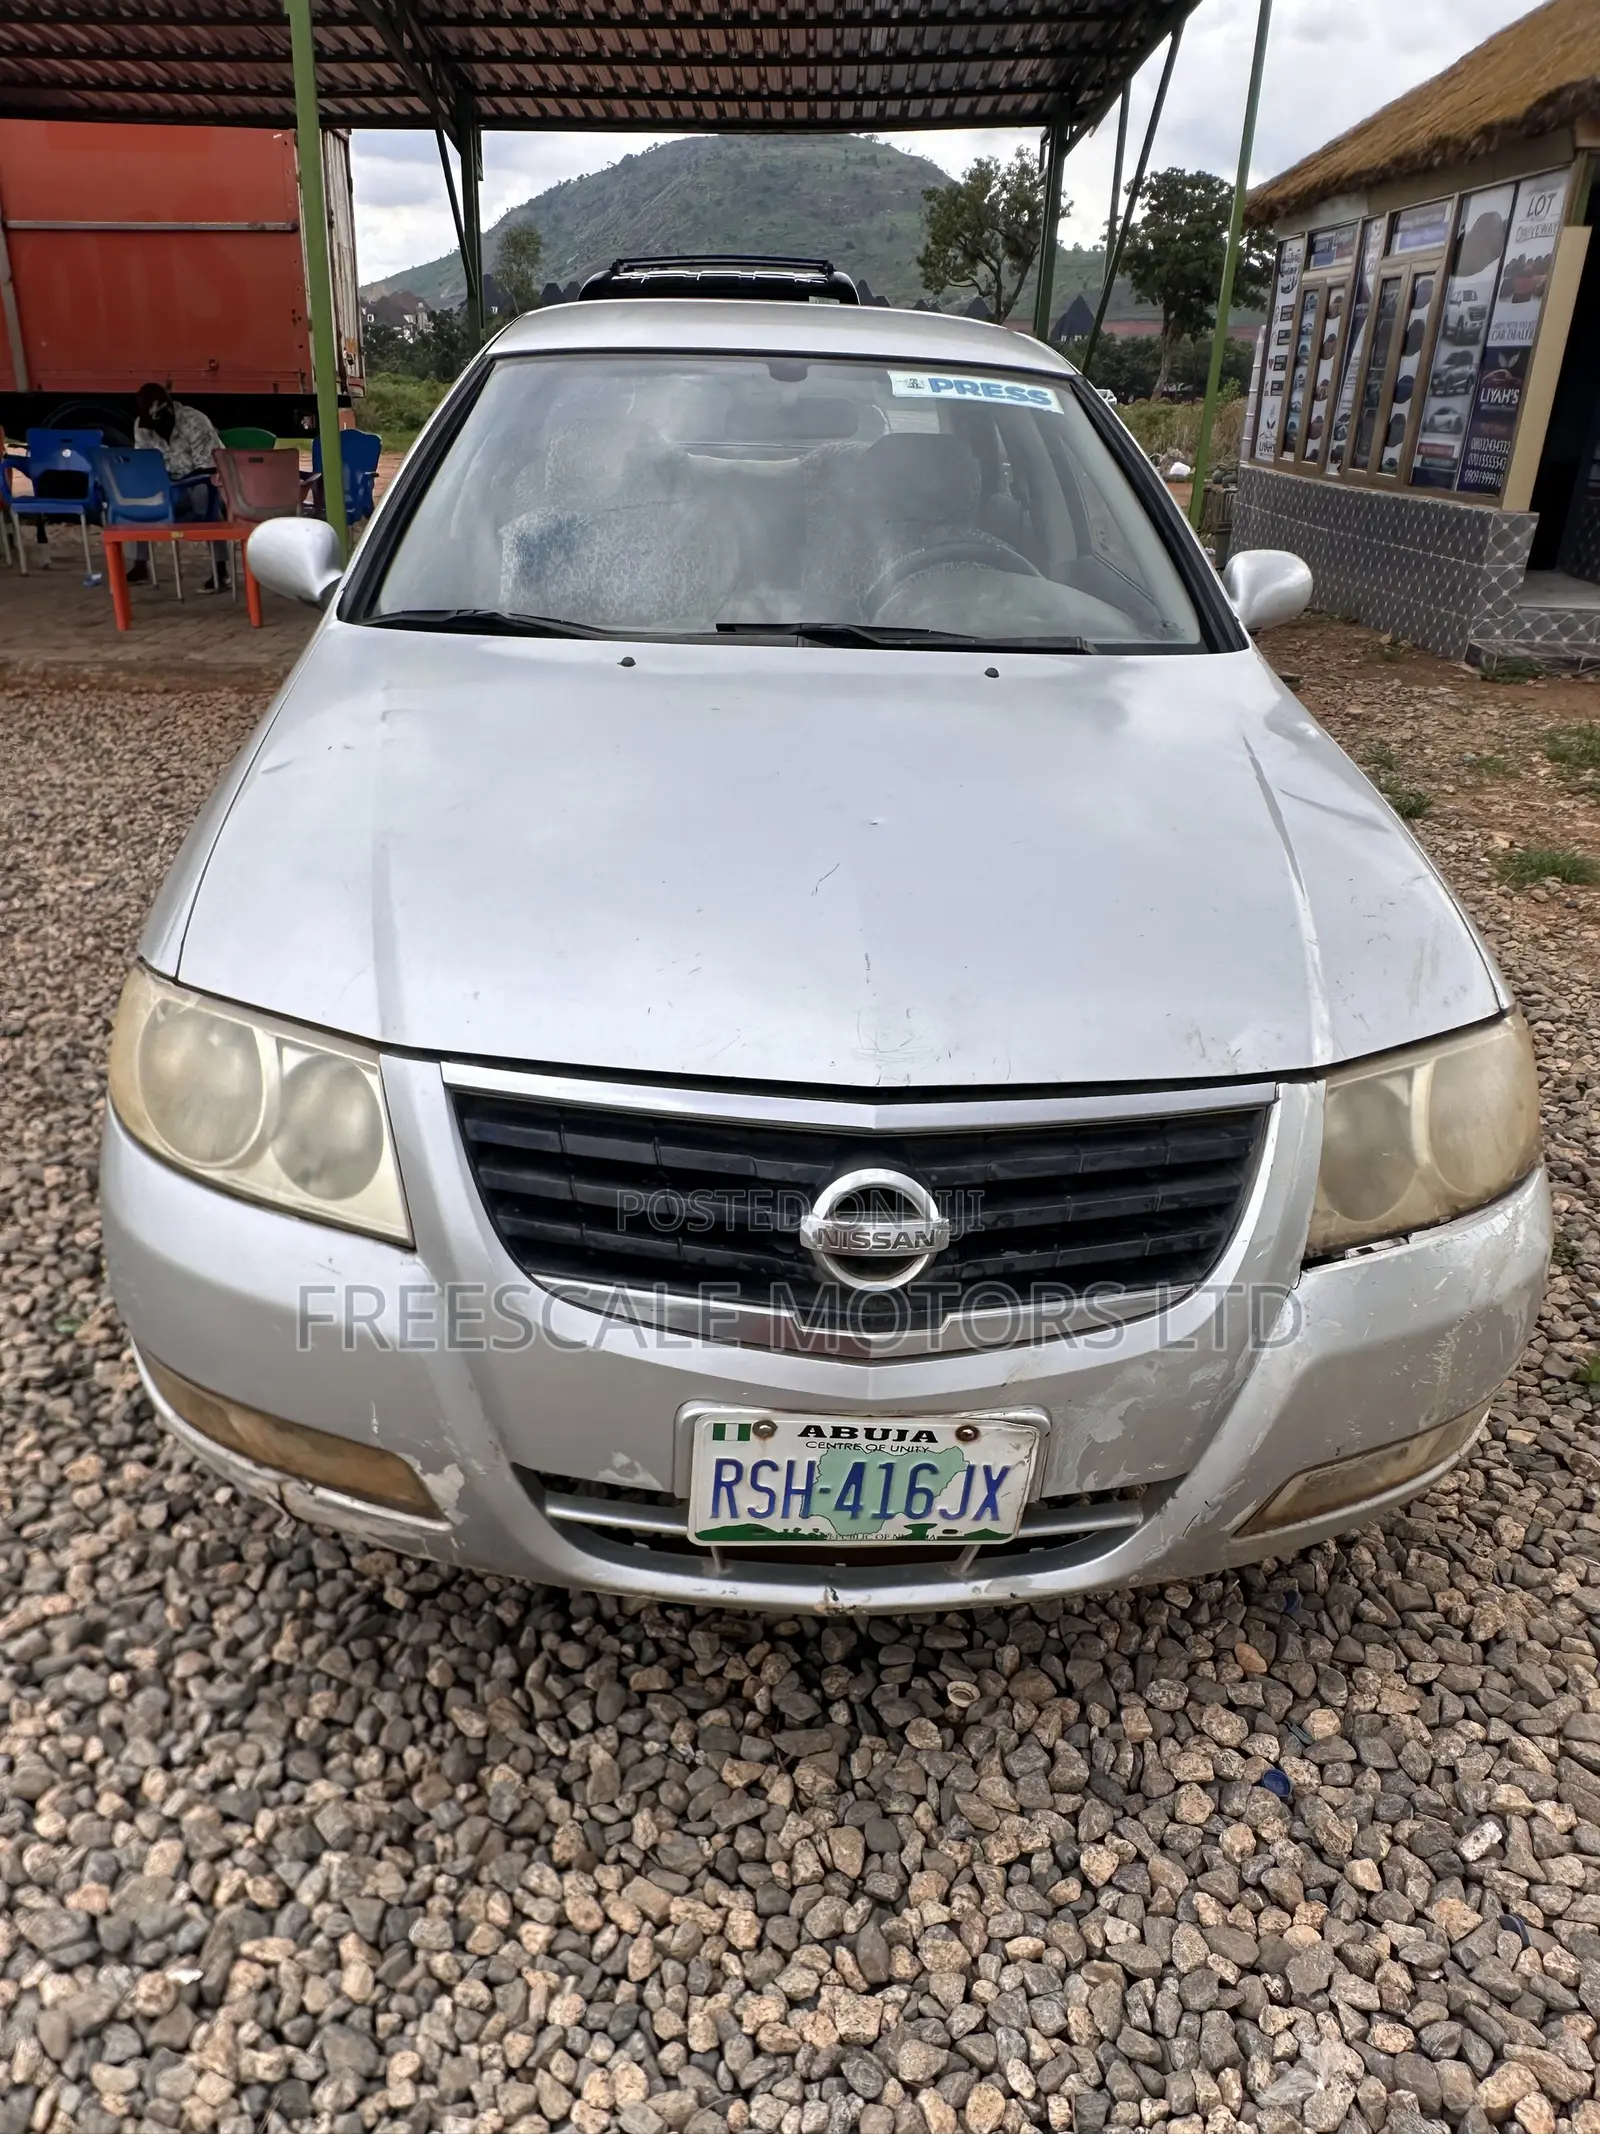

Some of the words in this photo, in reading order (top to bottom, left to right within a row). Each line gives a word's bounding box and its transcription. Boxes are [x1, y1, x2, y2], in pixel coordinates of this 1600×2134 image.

[928, 377, 1052, 405] PRESS
[1480, 388, 1520, 405] LIYAH'S
[816, 1227, 936, 1251] NISSAN
[798, 1425, 938, 1443] ABUJA
[805, 1440, 862, 1451] CENTRE
[865, 1443, 886, 1453] OF
[890, 1445, 930, 1453] UNITY
